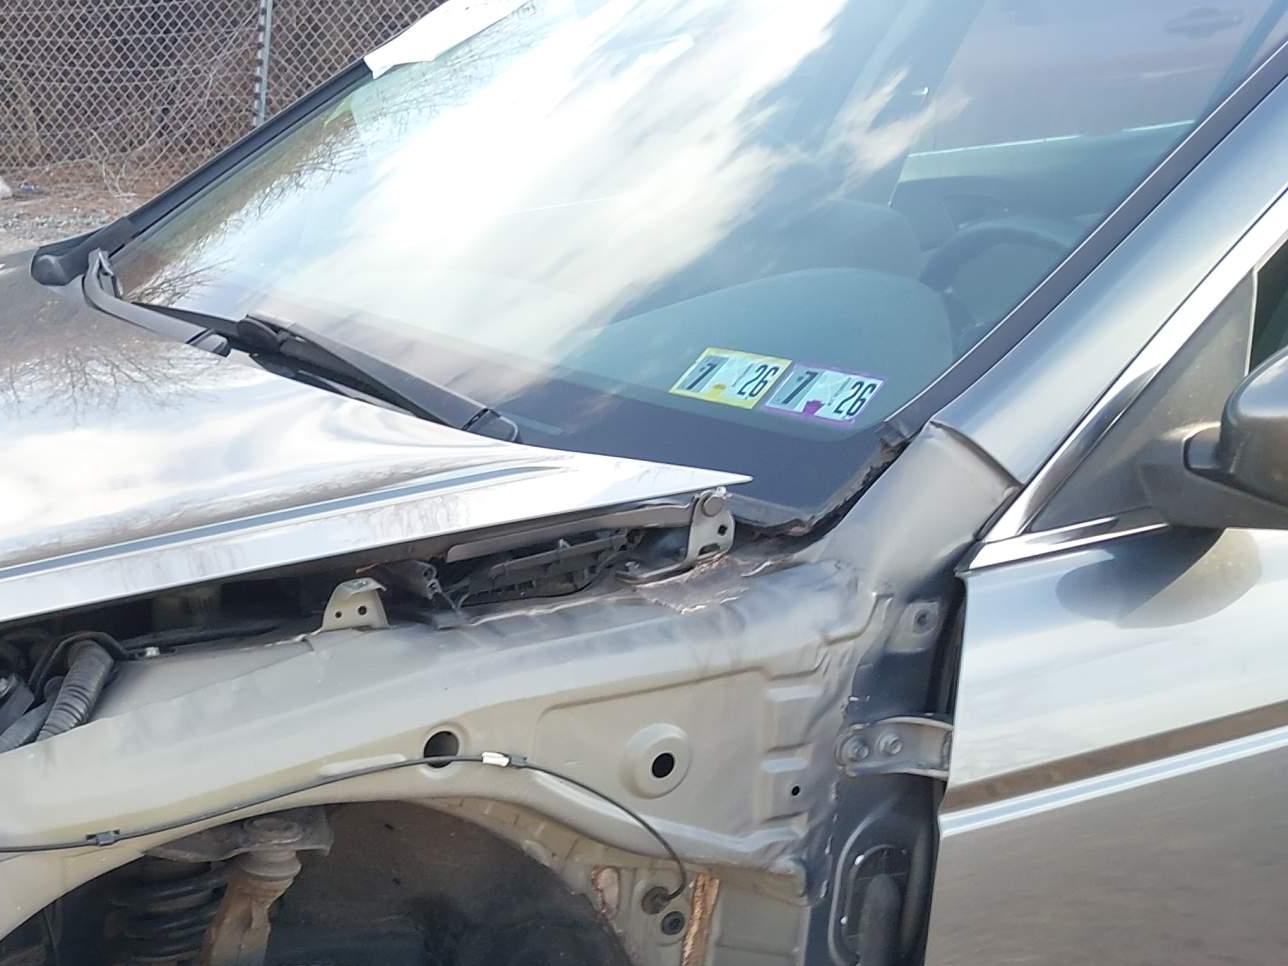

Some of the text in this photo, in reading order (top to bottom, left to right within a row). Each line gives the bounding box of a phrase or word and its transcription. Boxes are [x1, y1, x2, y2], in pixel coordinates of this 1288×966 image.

[685, 362, 780, 399] 7 26
[782, 370, 878, 418] 7 26
